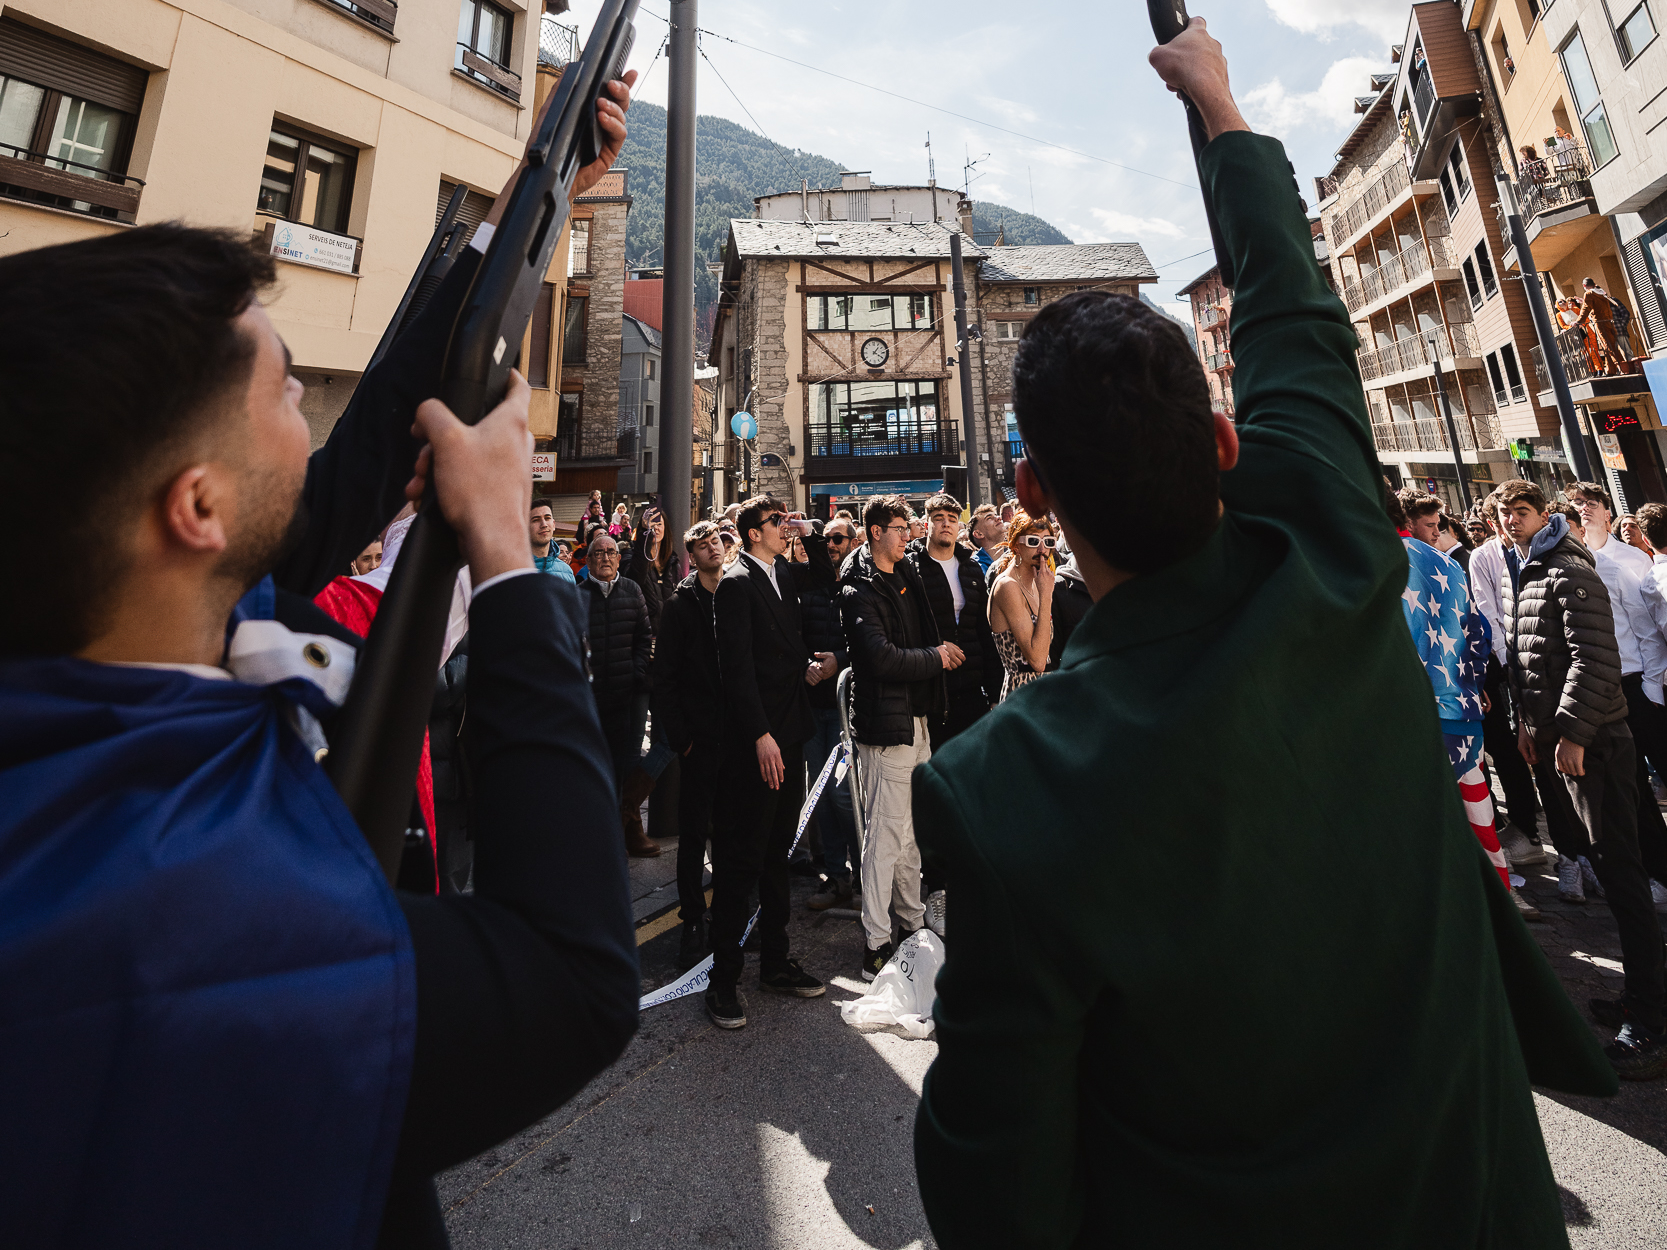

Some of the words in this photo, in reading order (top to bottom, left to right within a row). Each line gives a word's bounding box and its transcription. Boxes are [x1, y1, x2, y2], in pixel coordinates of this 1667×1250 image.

[308, 233, 328, 244] SERVEIS
[328, 238, 336, 246] DE
[336, 240, 353, 250] NETEJA
[273, 245, 303, 258] ENSINET
